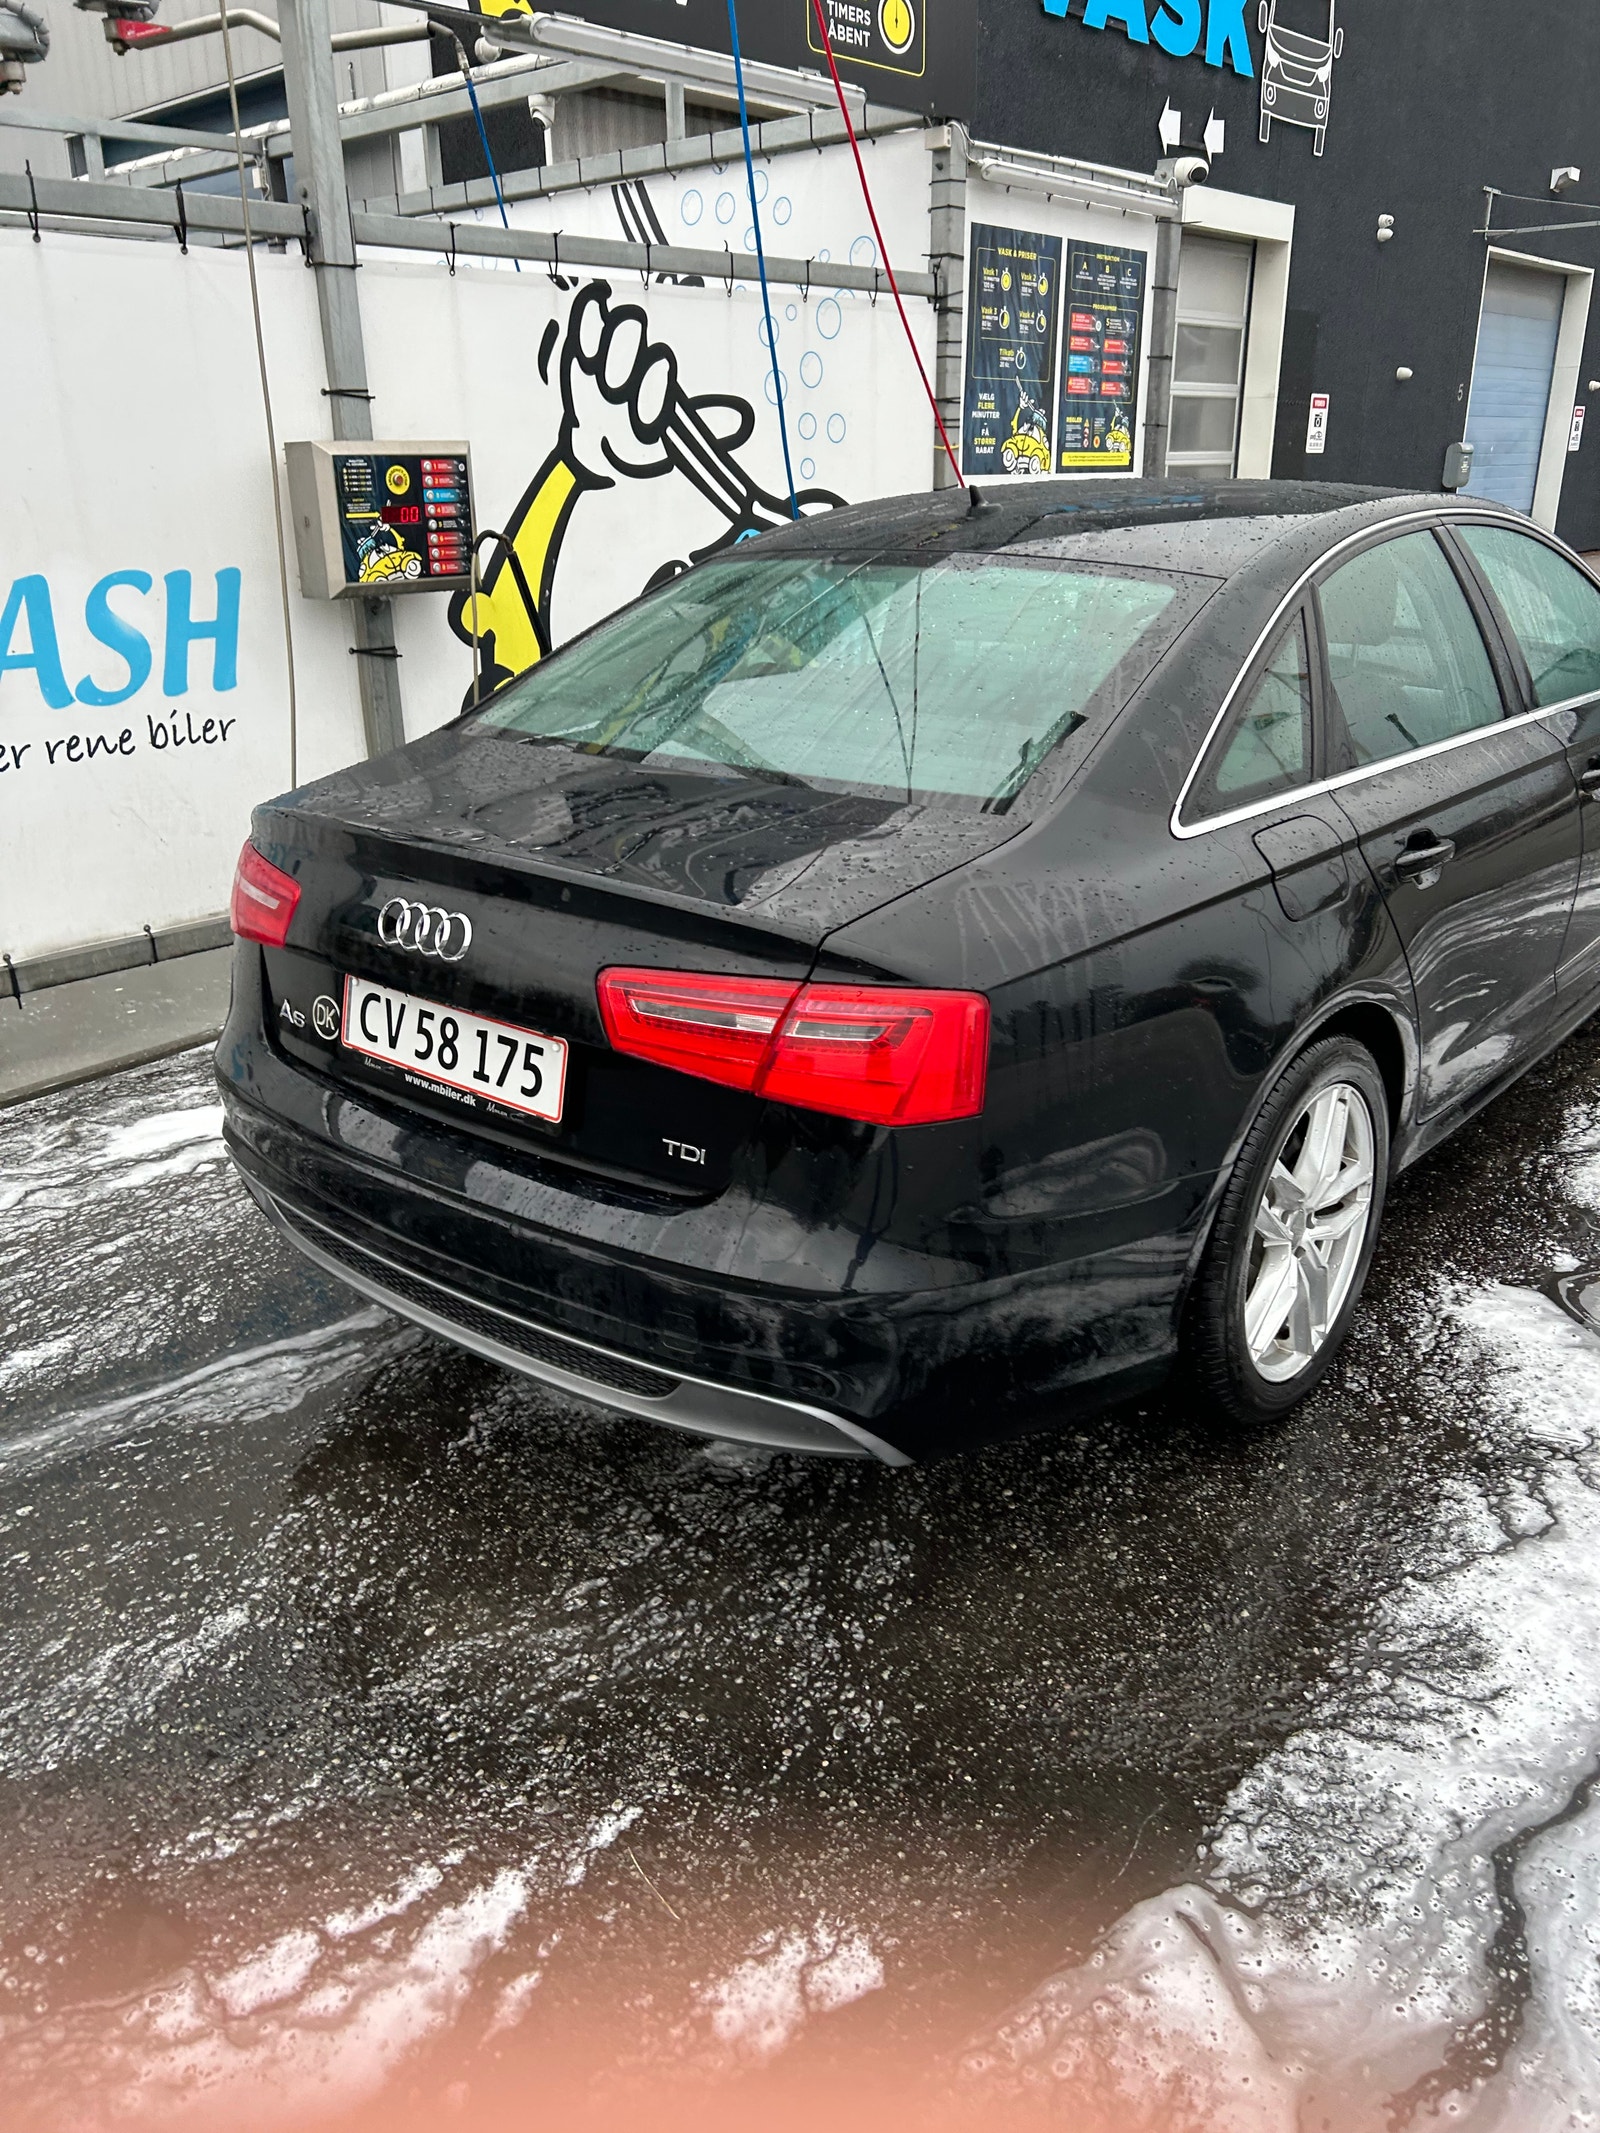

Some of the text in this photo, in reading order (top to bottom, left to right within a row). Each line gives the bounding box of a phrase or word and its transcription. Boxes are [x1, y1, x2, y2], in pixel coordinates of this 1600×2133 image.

[826, 0, 871, 26] TIMERS
[827, 18, 871, 48] ÅBENT
[1044, 0, 1255, 78] ASK
[997, 247, 1012, 257] VASK
[1018, 249, 1037, 260] PRISER
[1082, 261, 1088, 270] A
[1105, 265, 1110, 273] B
[1127, 268, 1132, 276] C
[1106, 318, 1110, 326] 5
[1457, 384, 1464, 401] 5
[978, 402, 995, 410] FLERE
[981, 428, 989, 436] FÅ
[974, 437, 996, 445] STØRRE
[975, 446, 994, 454] RABAT
[400, 506, 419, 523] 00
[45, 729, 136, 764] rene
[147, 709, 236, 750] biler
[317, 1003, 336, 1031] DK
[359, 992, 545, 1098] CV 58 175
[404, 1073, 477, 1108] www.mbiler.dk
[662, 1138, 706, 1165] TDI
